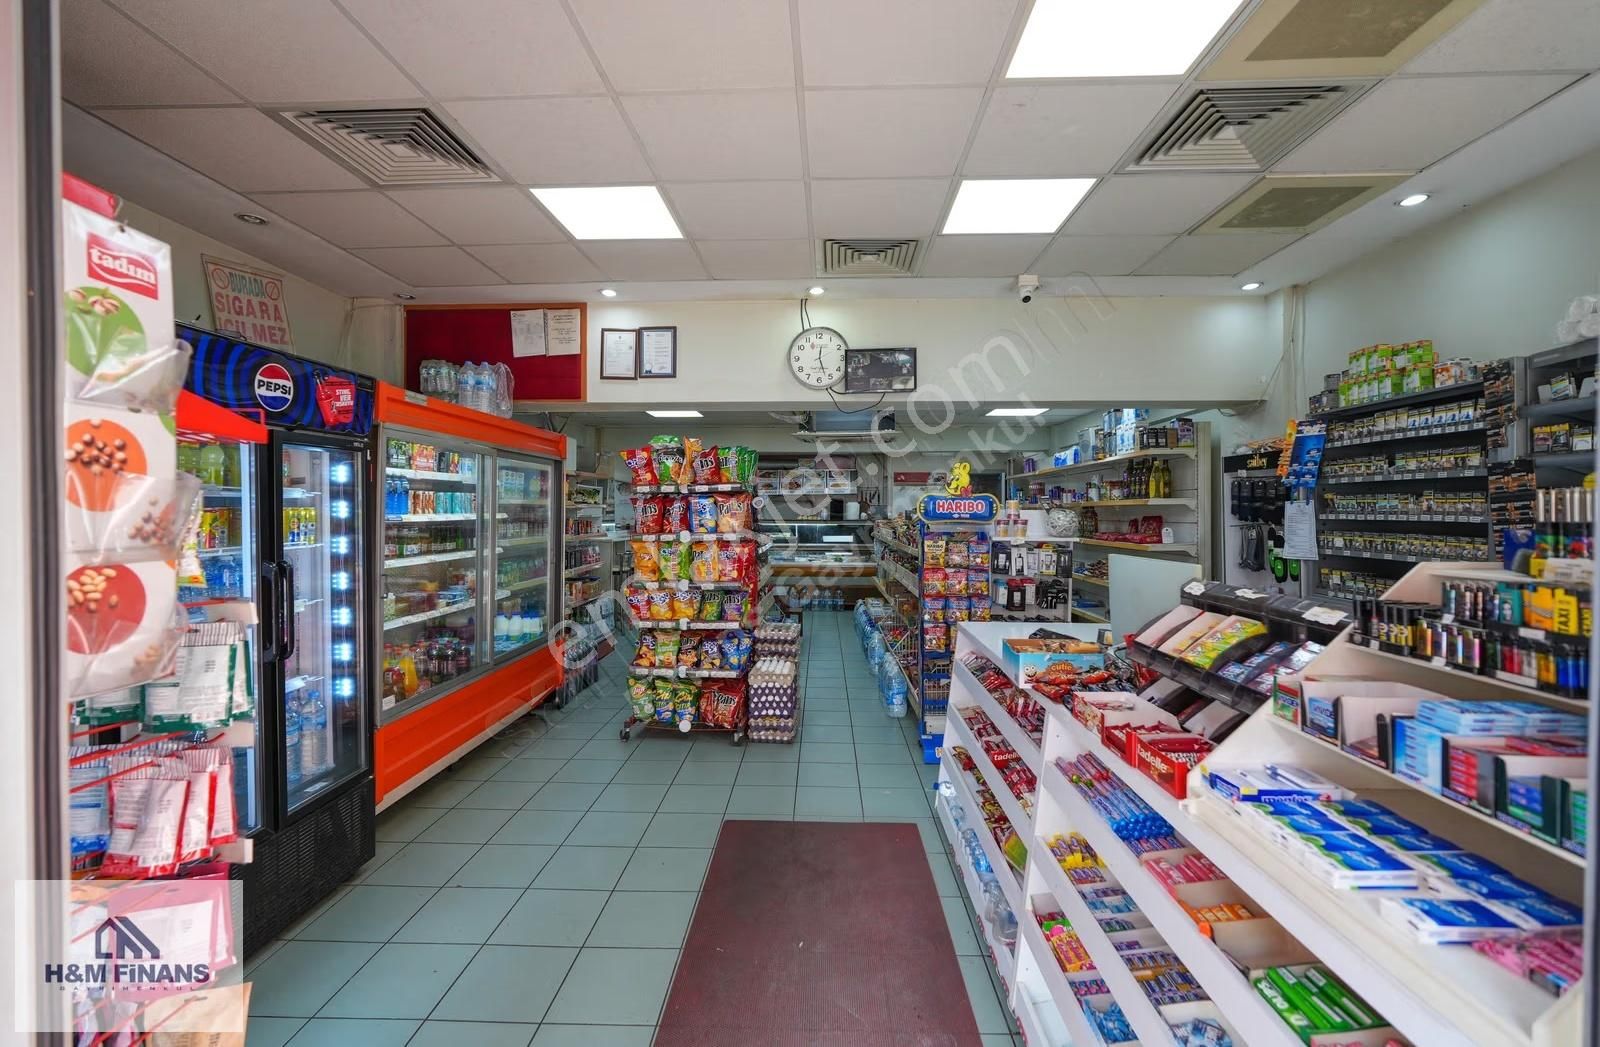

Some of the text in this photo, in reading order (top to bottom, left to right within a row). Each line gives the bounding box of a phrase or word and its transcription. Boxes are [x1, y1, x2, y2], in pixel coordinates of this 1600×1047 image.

[89, 249, 156, 285] tadım
[229, 272, 265, 299] BURADA
[257, 379, 292, 396] PEPSI
[935, 500, 986, 513] HARIBO
[1558, 607, 1570, 633] TAXI
[1051, 662, 1073, 671] cutie
[1136, 743, 1168, 774] tadelle
